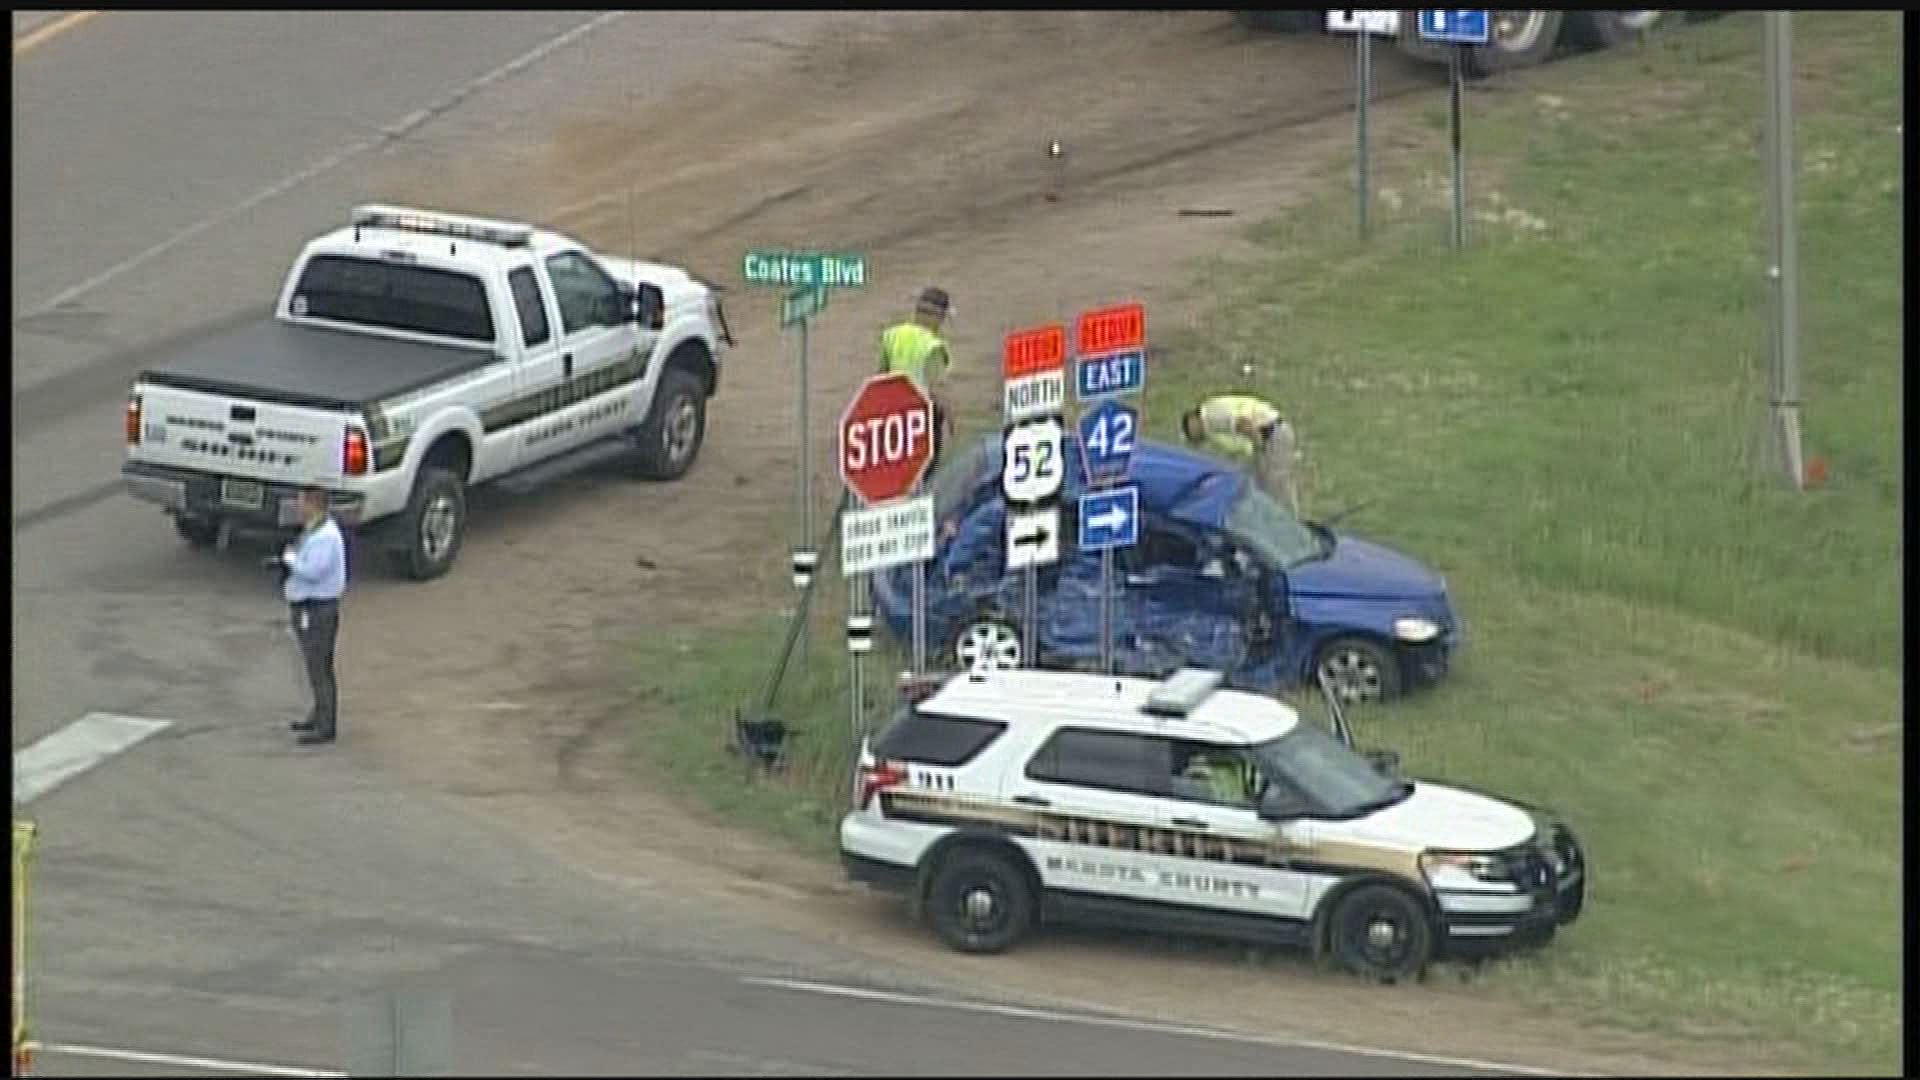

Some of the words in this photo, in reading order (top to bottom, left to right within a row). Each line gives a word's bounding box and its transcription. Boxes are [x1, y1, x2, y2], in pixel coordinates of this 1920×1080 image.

[744, 255, 812, 283] Coates
[1086, 357, 1133, 391] EAST
[1009, 377, 1061, 410] NORTH
[848, 410, 926, 470] STOP
[1087, 412, 1132, 456] 42
[1014, 442, 1053, 482] 52
